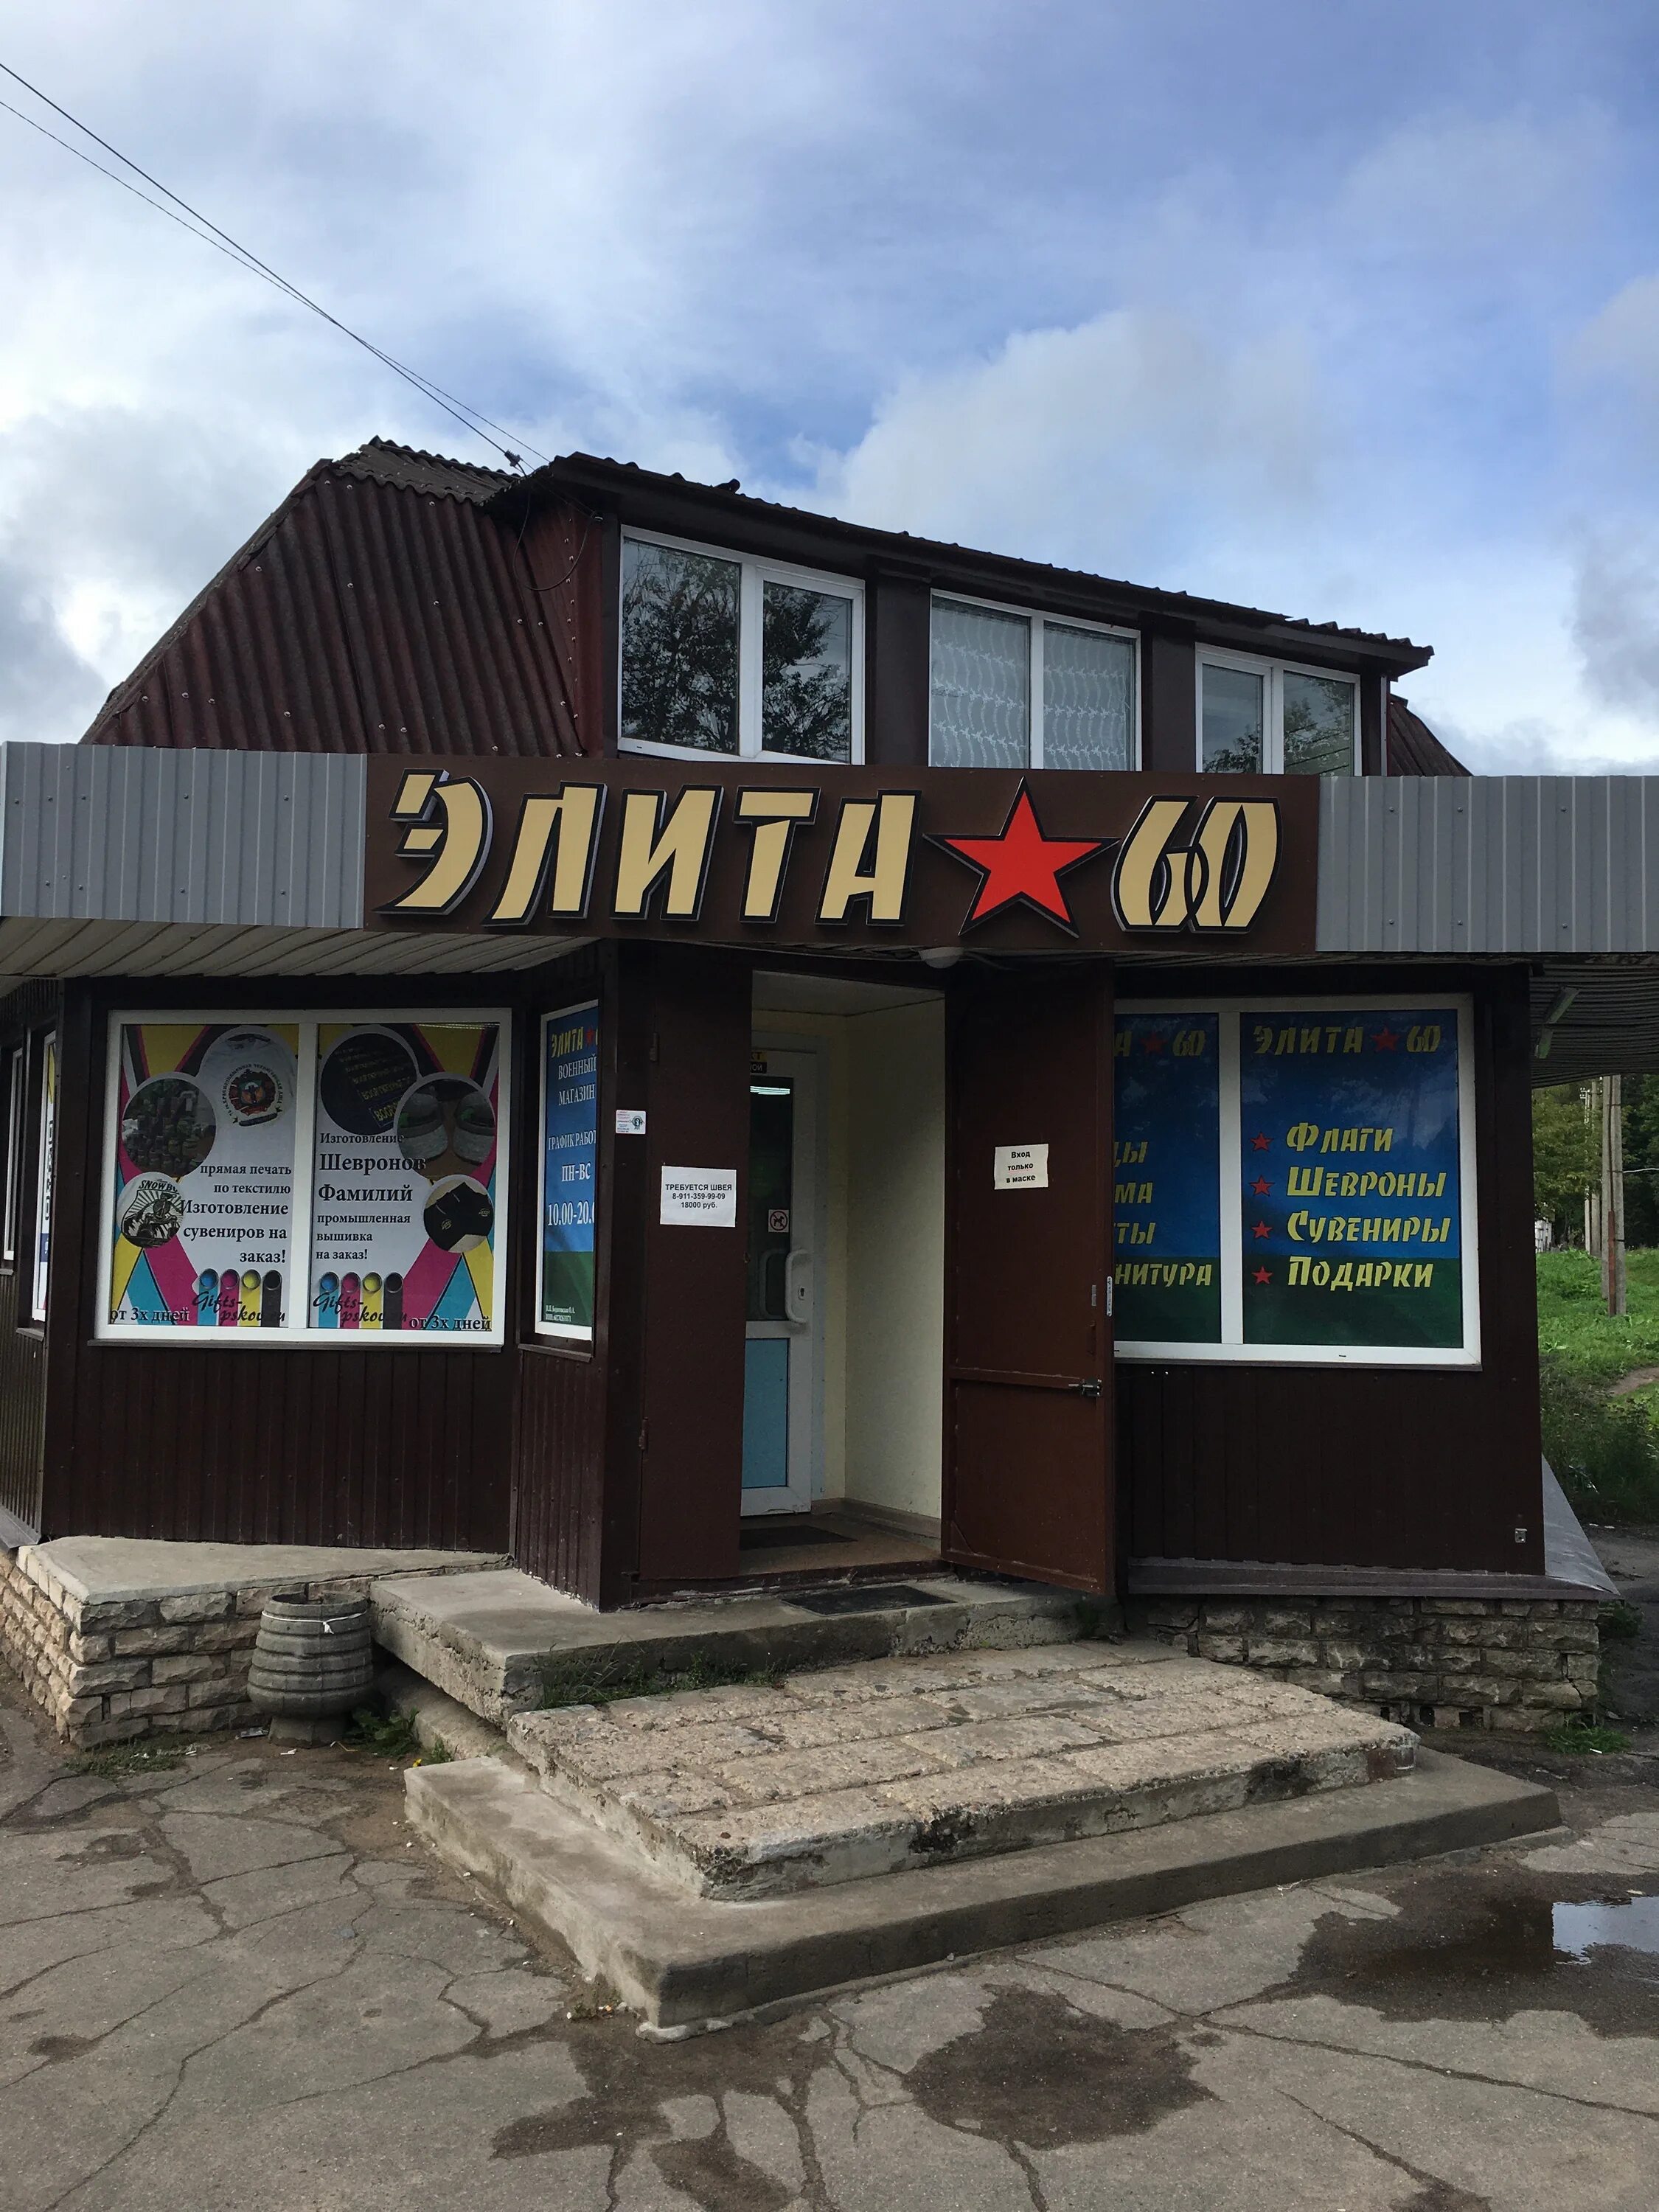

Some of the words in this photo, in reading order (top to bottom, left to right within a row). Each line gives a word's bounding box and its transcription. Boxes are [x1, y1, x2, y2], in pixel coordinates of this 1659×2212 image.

[372, 768, 922, 926] ЭЛИТА
[1110, 794, 1283, 933] 60
[551, 1026, 584, 1058] ЭЛИТА
[1172, 1030, 1206, 1057] 60
[1253, 1026, 1363, 1055] ЭЛИТА
[1406, 1025, 1441, 1053] 60
[558, 1053, 597, 1080] ВОЕННЫЙ
[559, 1084, 596, 1106] МАГАЗИН
[320, 1132, 404, 1144] Изготовление
[548, 1133, 574, 1151] ГРАФИК
[200, 1166, 247, 1177] прямая
[249, 1165, 292, 1175] печать
[319, 1153, 427, 1176] Шевронов
[561, 1162, 591, 1182] ПН-ВС
[1007, 1163, 1034, 1171] только
[1012, 1175, 1036, 1183] маске
[214, 1184, 229, 1194] по
[232, 1184, 291, 1194] текстилю
[318, 1183, 414, 1202] Фамилий
[181, 1200, 289, 1215] Изготовление
[703, 1201, 717, 1210] руб.
[316, 1214, 411, 1226] промышленная
[183, 1226, 265, 1242] сувениров
[268, 1228, 288, 1239] на
[316, 1232, 374, 1242] вышивка
[239, 1249, 287, 1263] заказ!
[316, 1252, 330, 1260] на
[333, 1248, 369, 1260] заказ!
[151, 1307, 190, 1322] дней
[453, 1316, 492, 1332] дней
